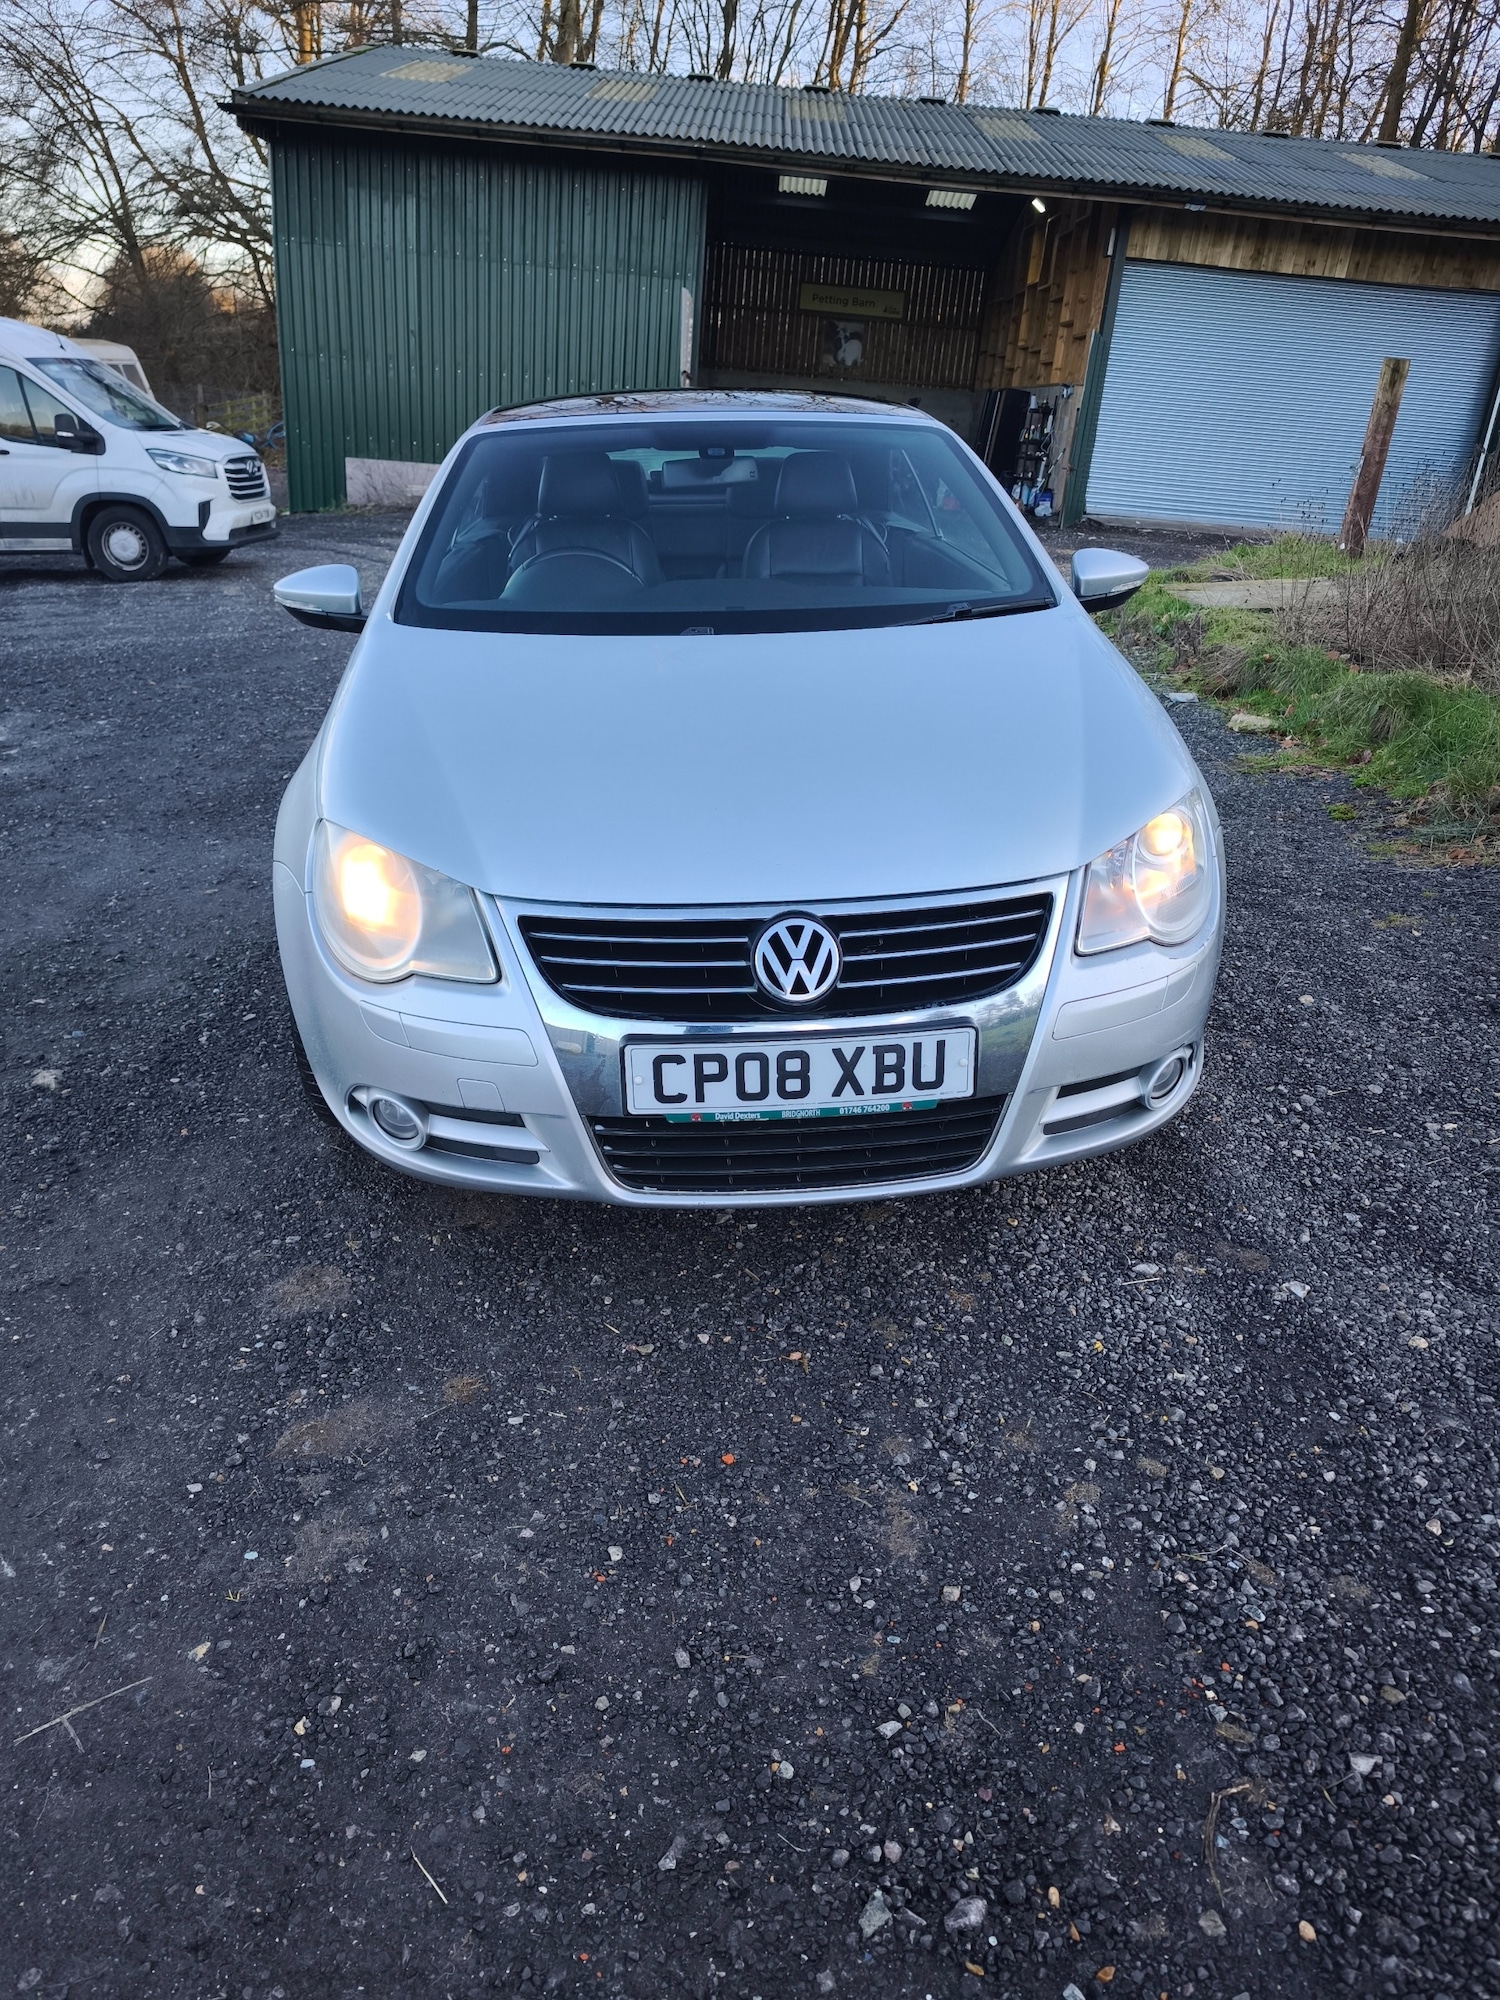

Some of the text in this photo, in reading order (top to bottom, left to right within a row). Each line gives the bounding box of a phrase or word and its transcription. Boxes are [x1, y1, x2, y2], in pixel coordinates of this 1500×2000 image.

[812, 293, 876, 308] Petting Barn
[757, 920, 837, 998] VW
[652, 1040, 946, 1104] CP08 XBU
[715, 1104, 890, 1120] David Dexters BRIDGNORTH 01746 764200
